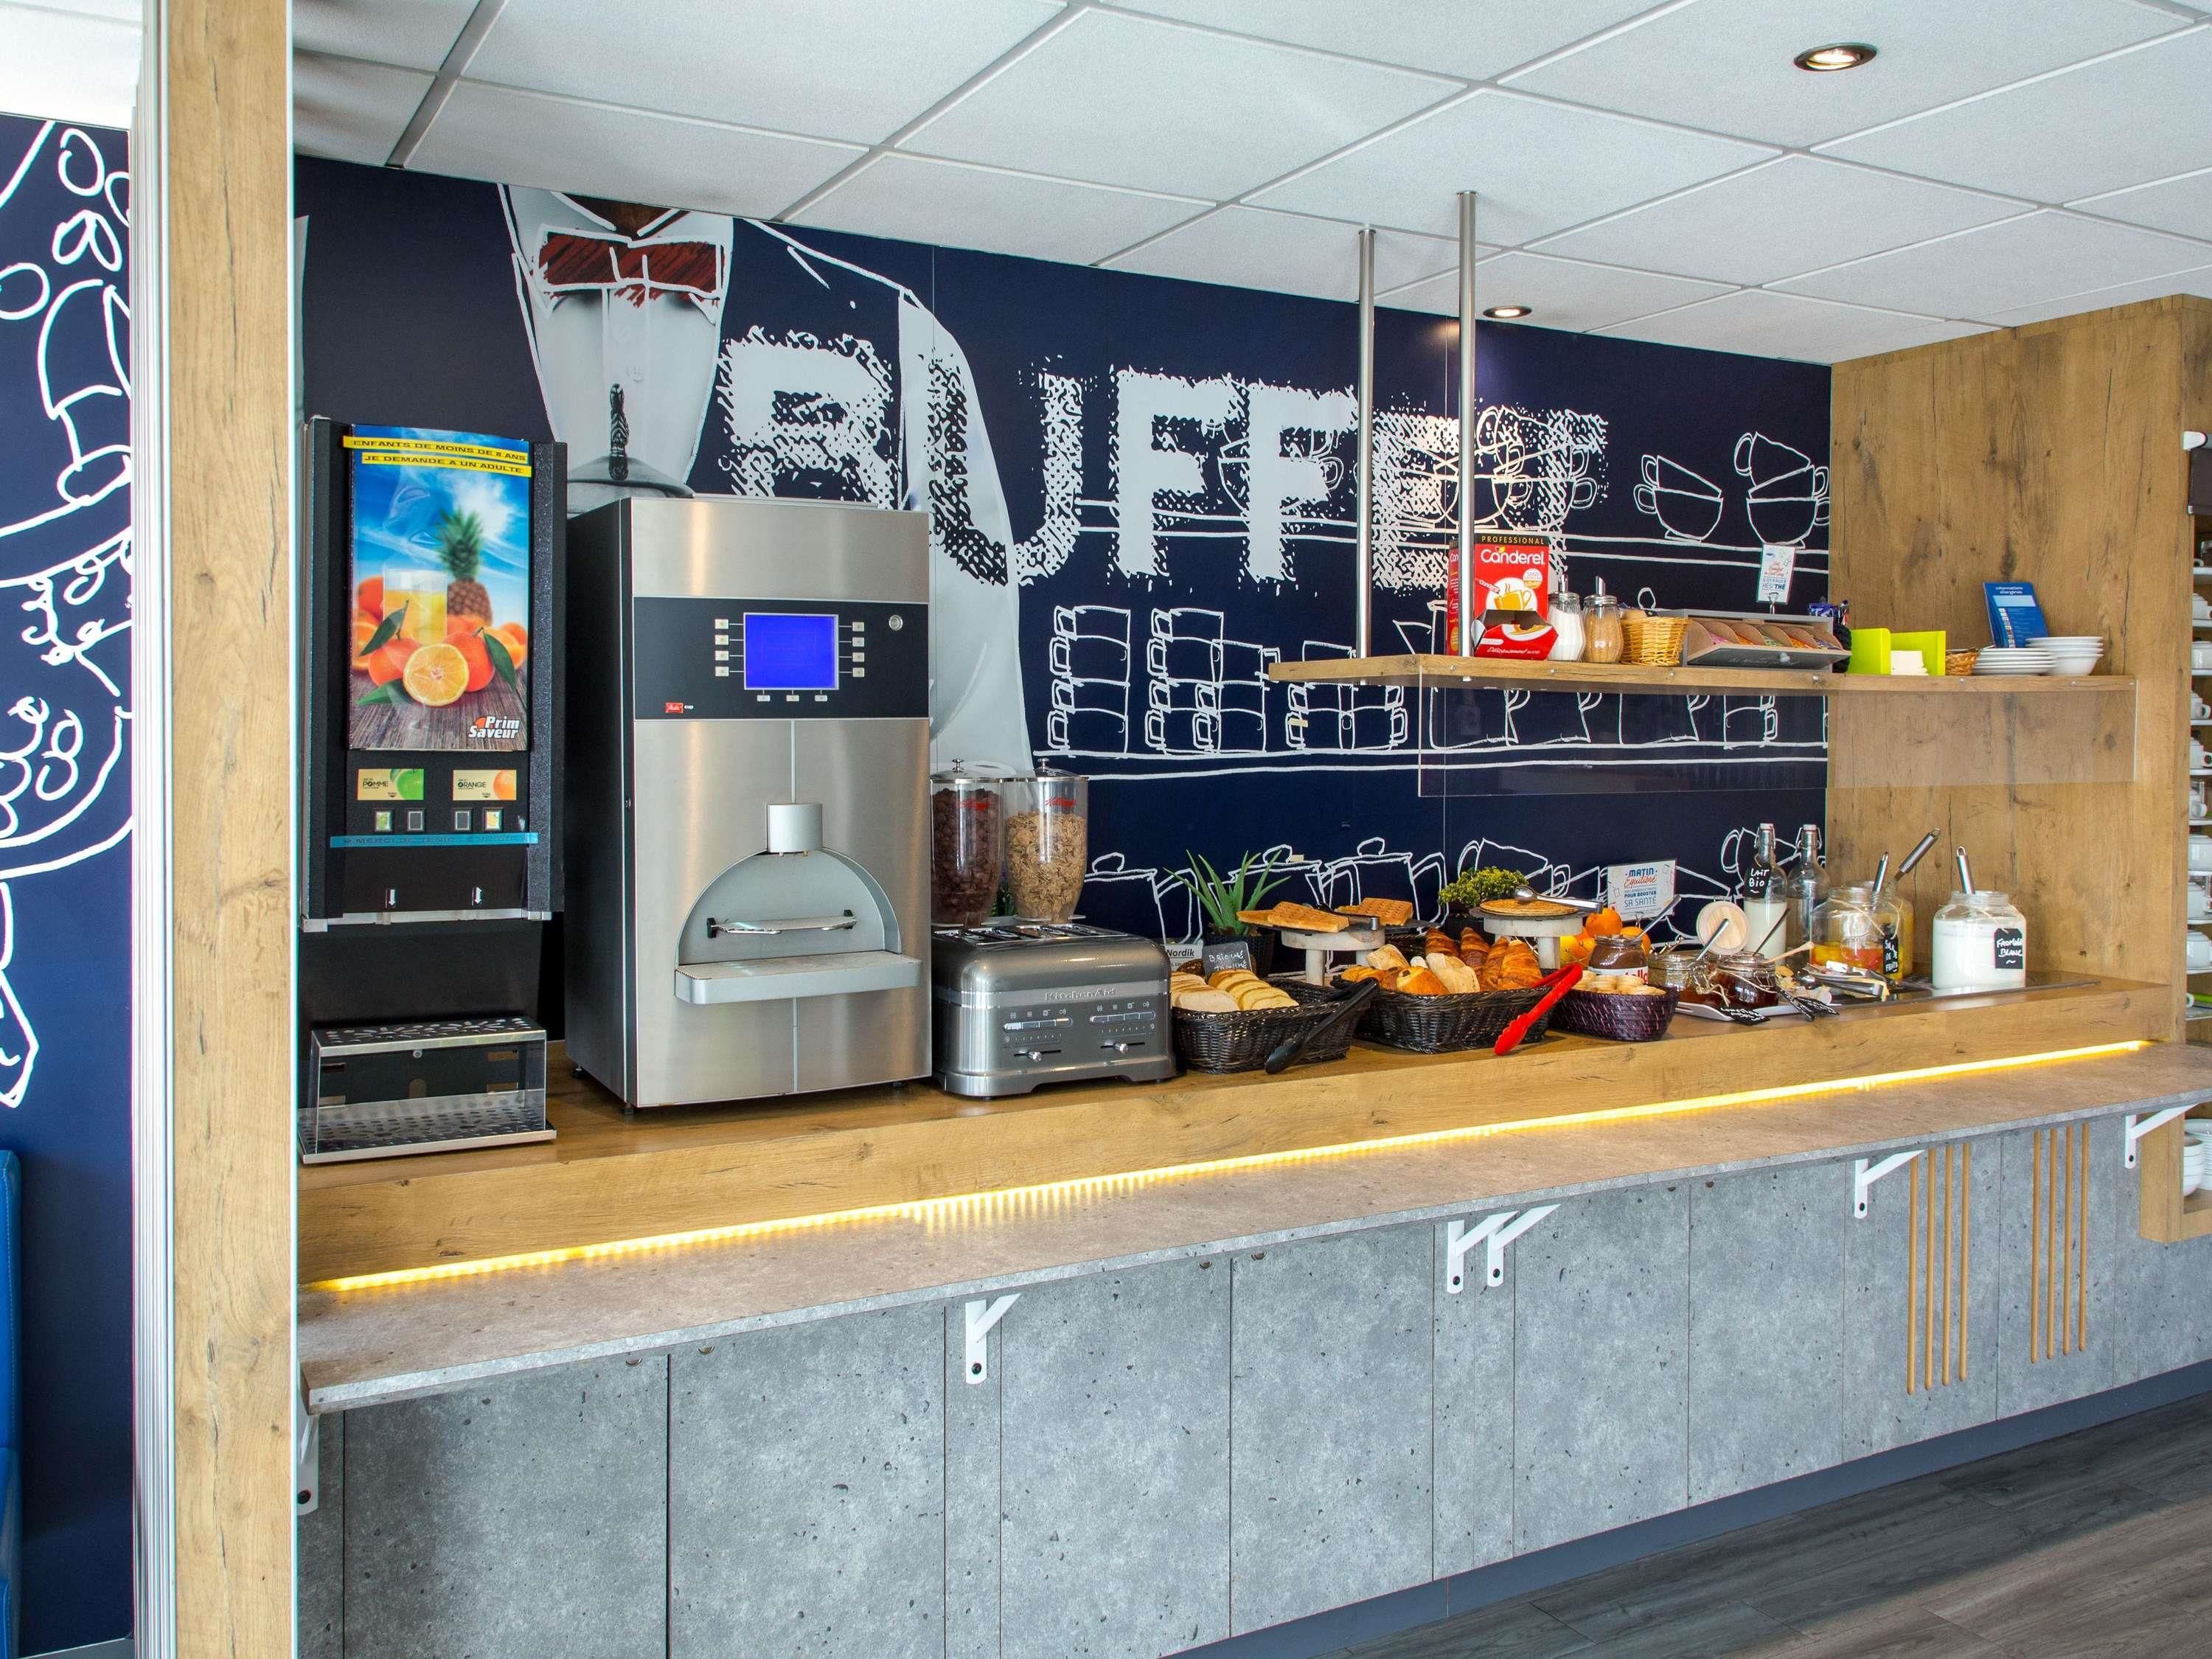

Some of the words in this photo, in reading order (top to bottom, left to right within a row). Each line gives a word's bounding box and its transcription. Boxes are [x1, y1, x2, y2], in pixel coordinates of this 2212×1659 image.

[436, 445, 474, 453] MOINS
[384, 456, 444, 465] DEMANDE
[480, 463, 521, 473] ADULTE
[1481, 535, 1545, 545] PROFESSIONAL
[1481, 549, 1545, 566] Canderel
[484, 715, 520, 729] Prim
[467, 725, 519, 739] Saveur
[1629, 867, 1655, 877] MATIN
[1635, 896, 1656, 906] SANTÉ
[1166, 948, 1194, 957] Nordik
[1998, 948, 2023, 957] BLANC
